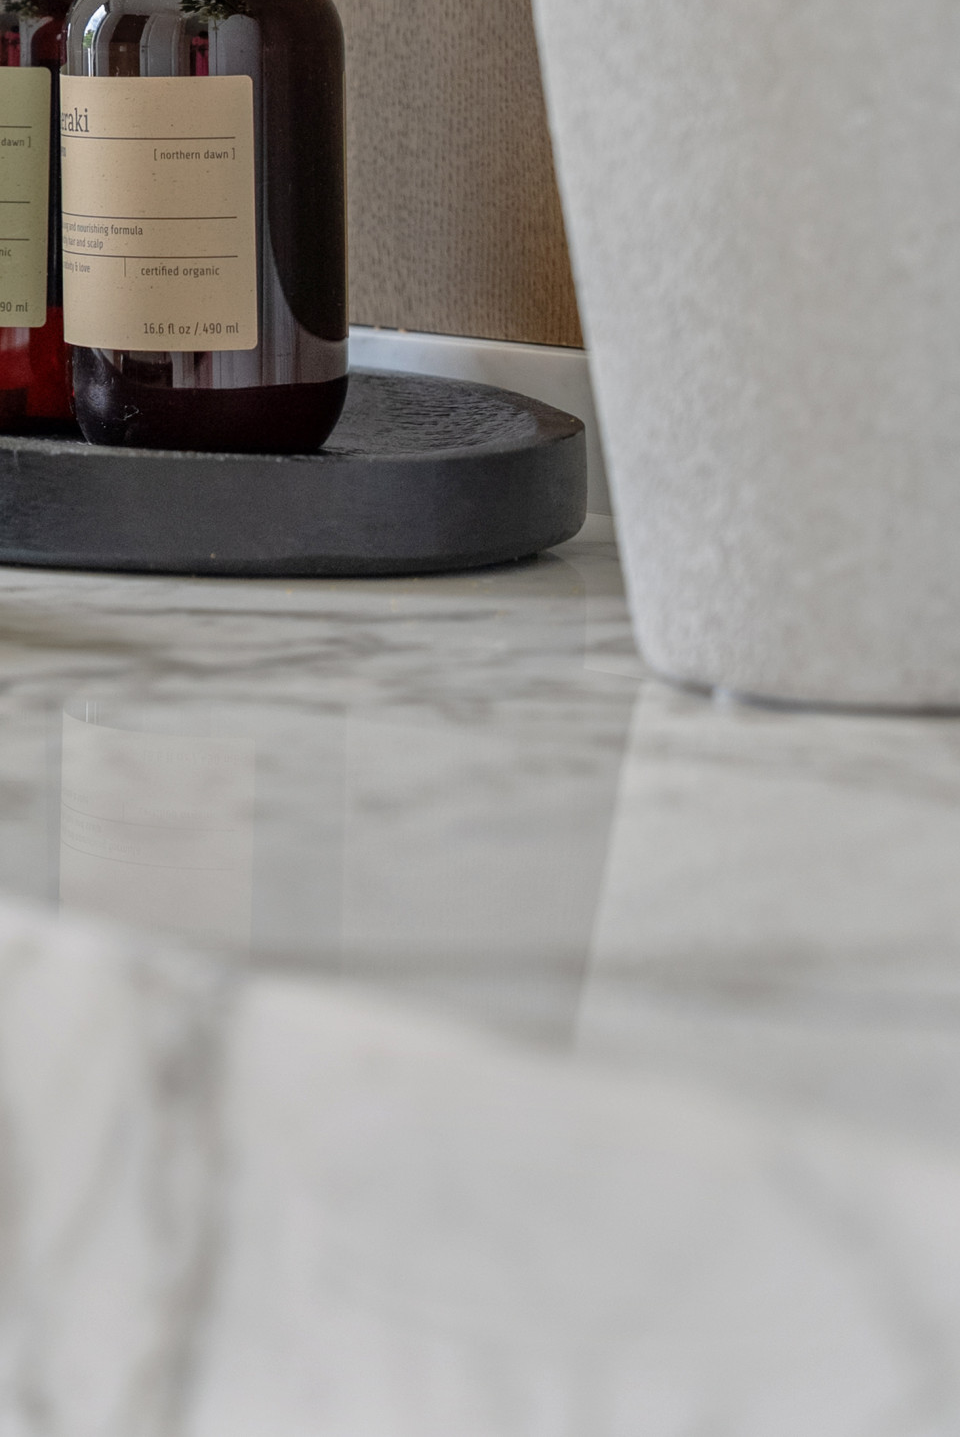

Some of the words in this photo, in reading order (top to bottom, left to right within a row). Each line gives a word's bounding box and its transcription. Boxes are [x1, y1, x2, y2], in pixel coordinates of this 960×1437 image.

[1, 137, 25, 147] dawn
[160, 149, 201, 160] northern
[203, 149, 229, 159] dawn
[77, 223, 109, 236] nourishing
[110, 224, 144, 235] formula
[87, 238, 104, 250] scalp
[141, 265, 179, 276] certified
[182, 265, 220, 278] organic
[15, 302, 28, 313] ml
[143, 322, 165, 335] 16.6
[167, 323, 175, 335] fl
[178, 325, 191, 335] oz
[203, 322, 222, 334] 490
[225, 322, 239, 334] ml
